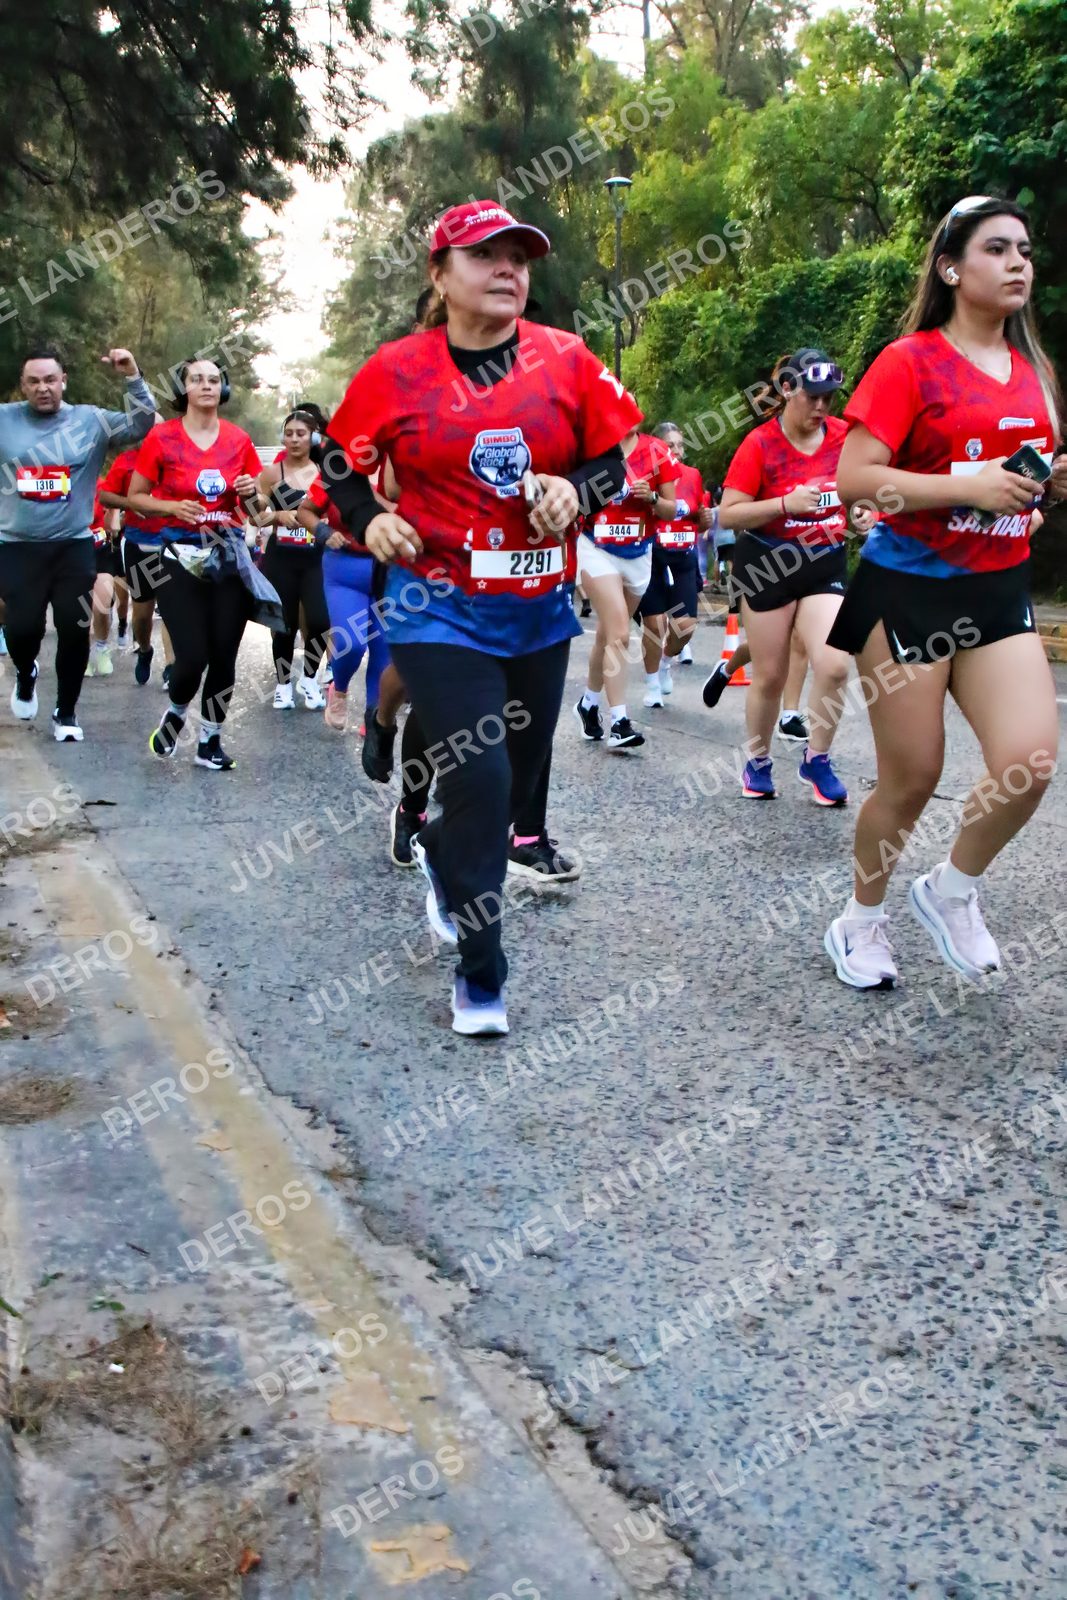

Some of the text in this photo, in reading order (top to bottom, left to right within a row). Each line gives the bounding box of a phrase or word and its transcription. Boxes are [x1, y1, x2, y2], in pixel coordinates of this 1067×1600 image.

[483, 435, 516, 444] BIMBO
[484, 446, 517, 459] Global
[480, 458, 505, 468] Race
[35, 480, 55, 490] 1318
[609, 525, 632, 536] 3444
[510, 550, 552, 576] 2291
